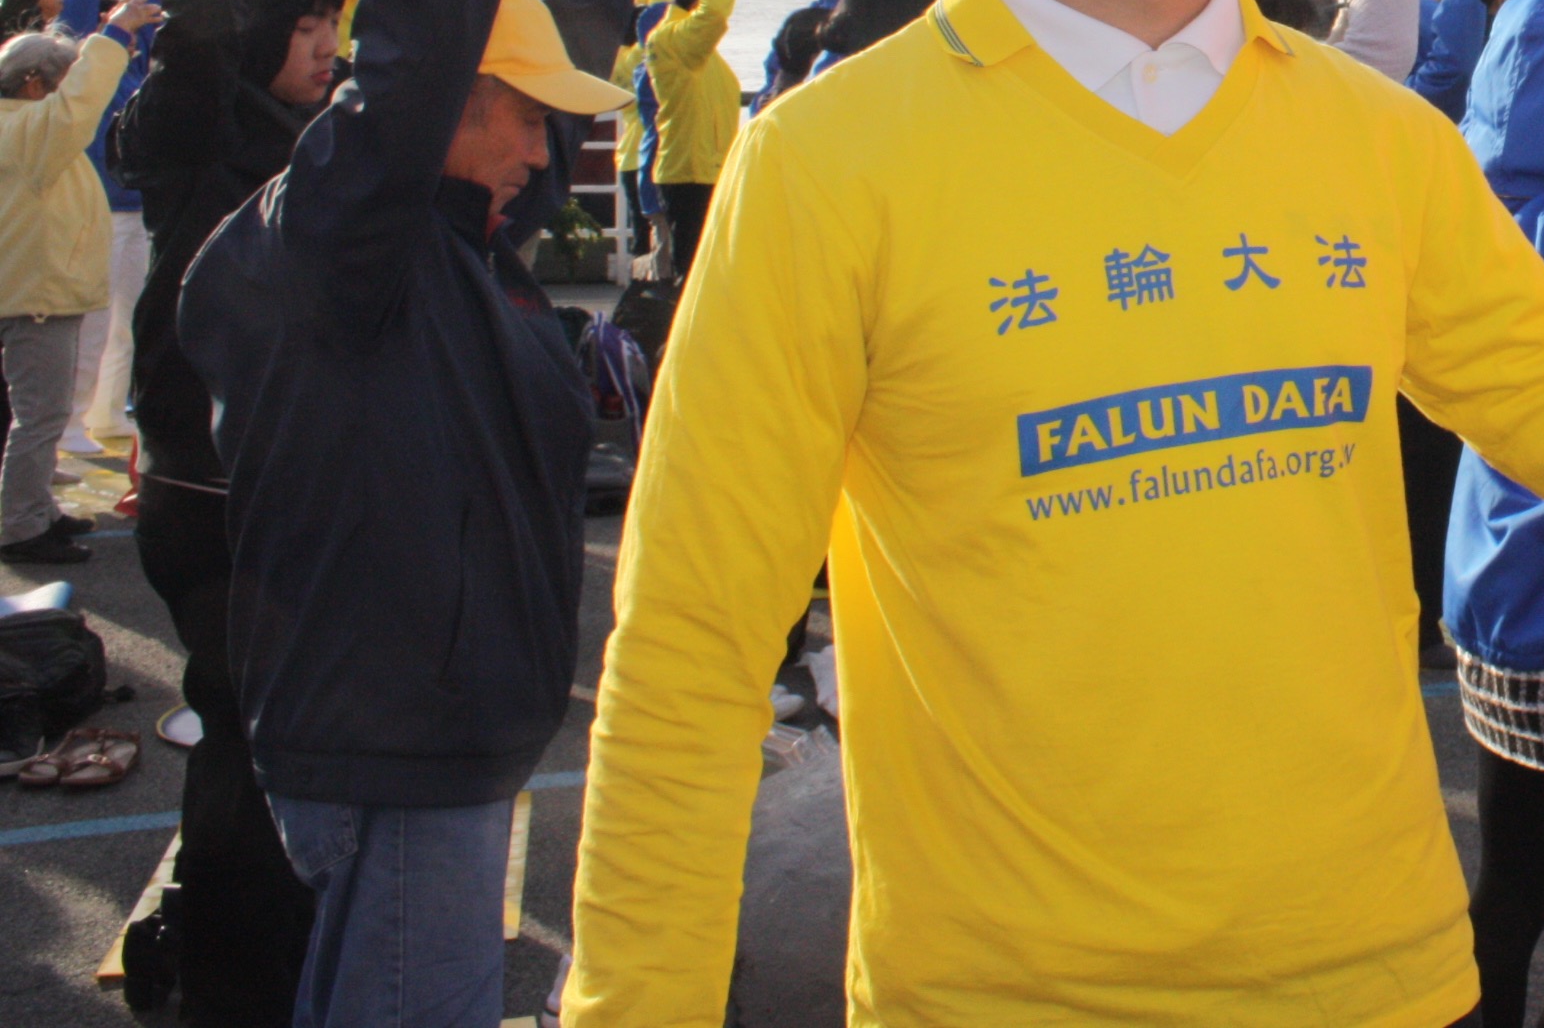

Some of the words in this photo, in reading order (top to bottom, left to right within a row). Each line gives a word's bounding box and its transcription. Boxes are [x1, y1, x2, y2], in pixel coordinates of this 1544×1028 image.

[988, 232, 1368, 336] 法輪大法
[1036, 390, 1221, 463] FALUN
[1242, 376, 1354, 425] DAFA
